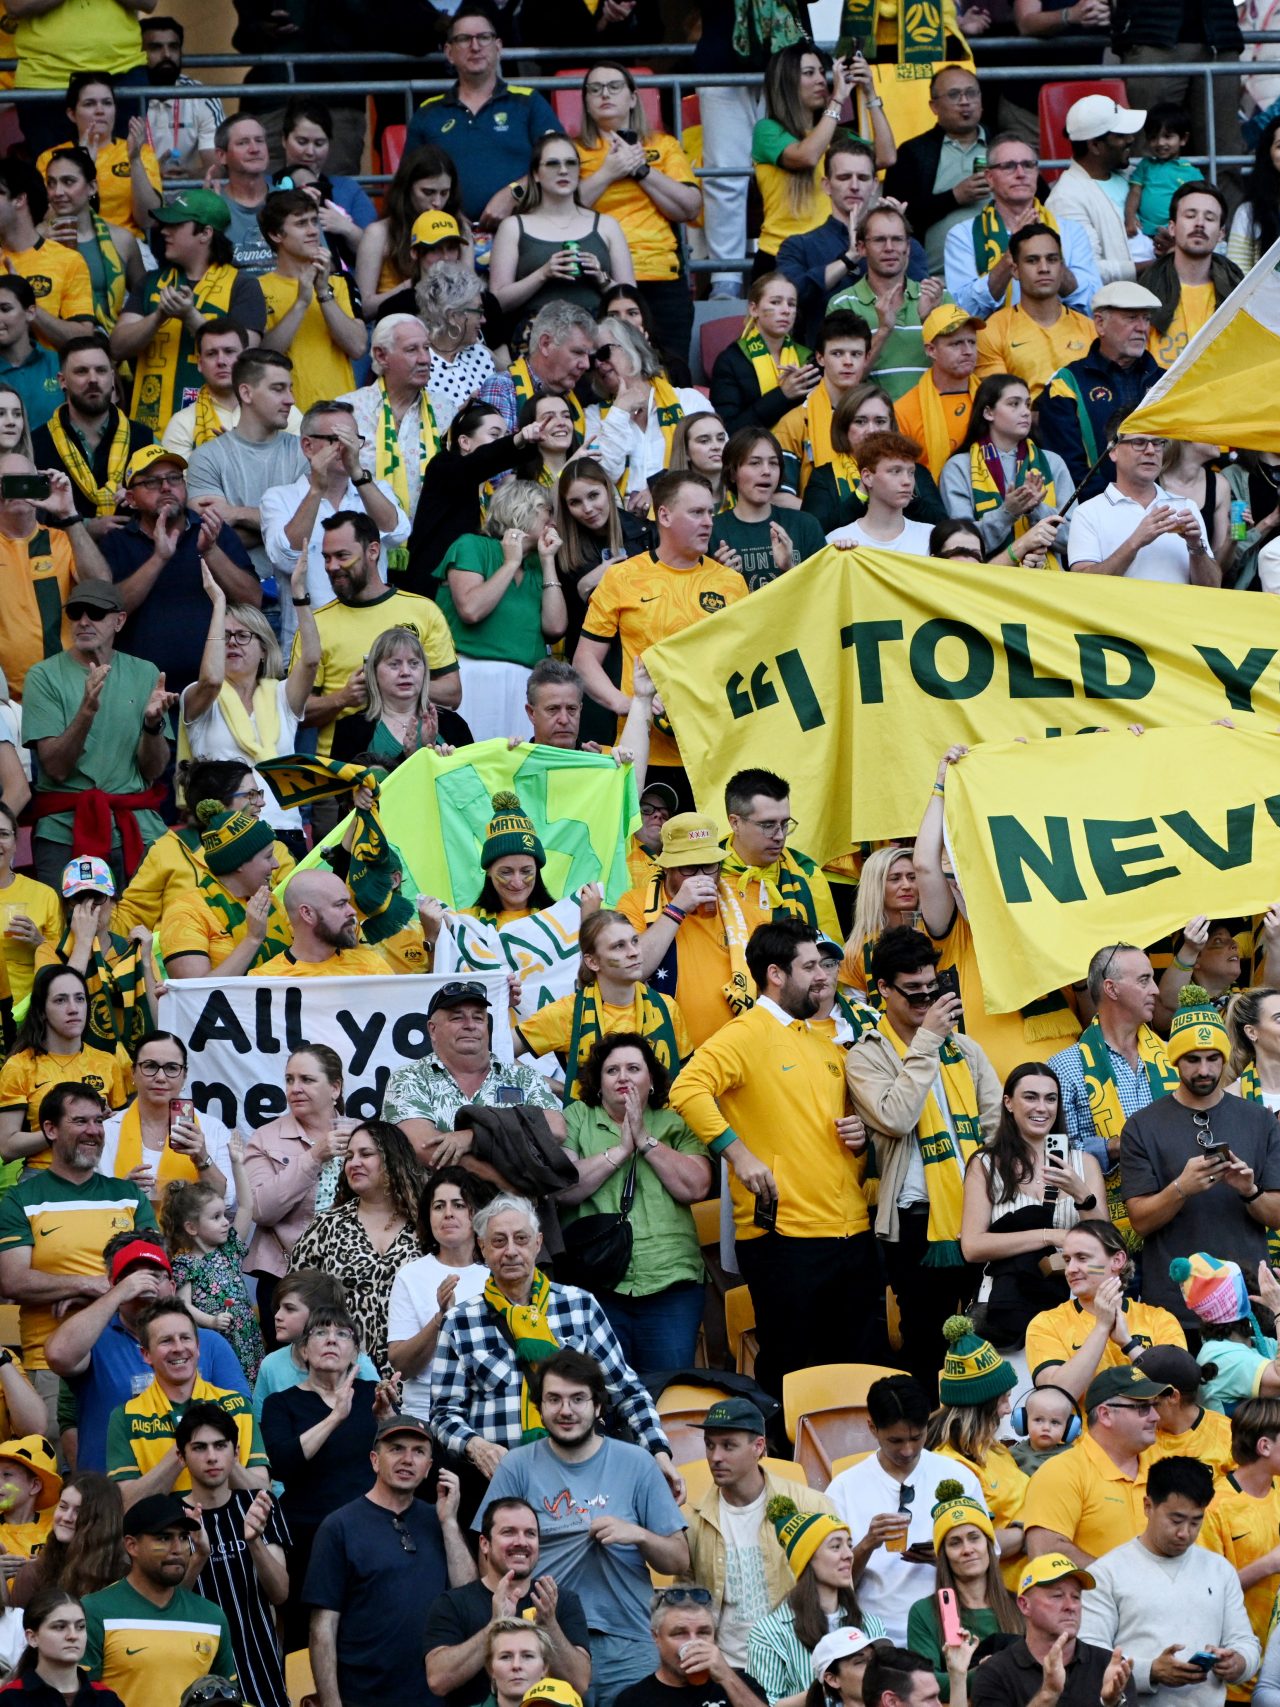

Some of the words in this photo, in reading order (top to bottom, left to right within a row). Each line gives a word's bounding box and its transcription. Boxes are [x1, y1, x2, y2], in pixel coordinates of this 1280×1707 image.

[432, 221, 454, 230] AUS
[840, 611, 1155, 704] TOLD
[188, 987, 310, 1054] All
[335, 1009, 494, 1077] yo
[191, 1065, 391, 1131] ned
[530, 1685, 555, 1696] AUS
